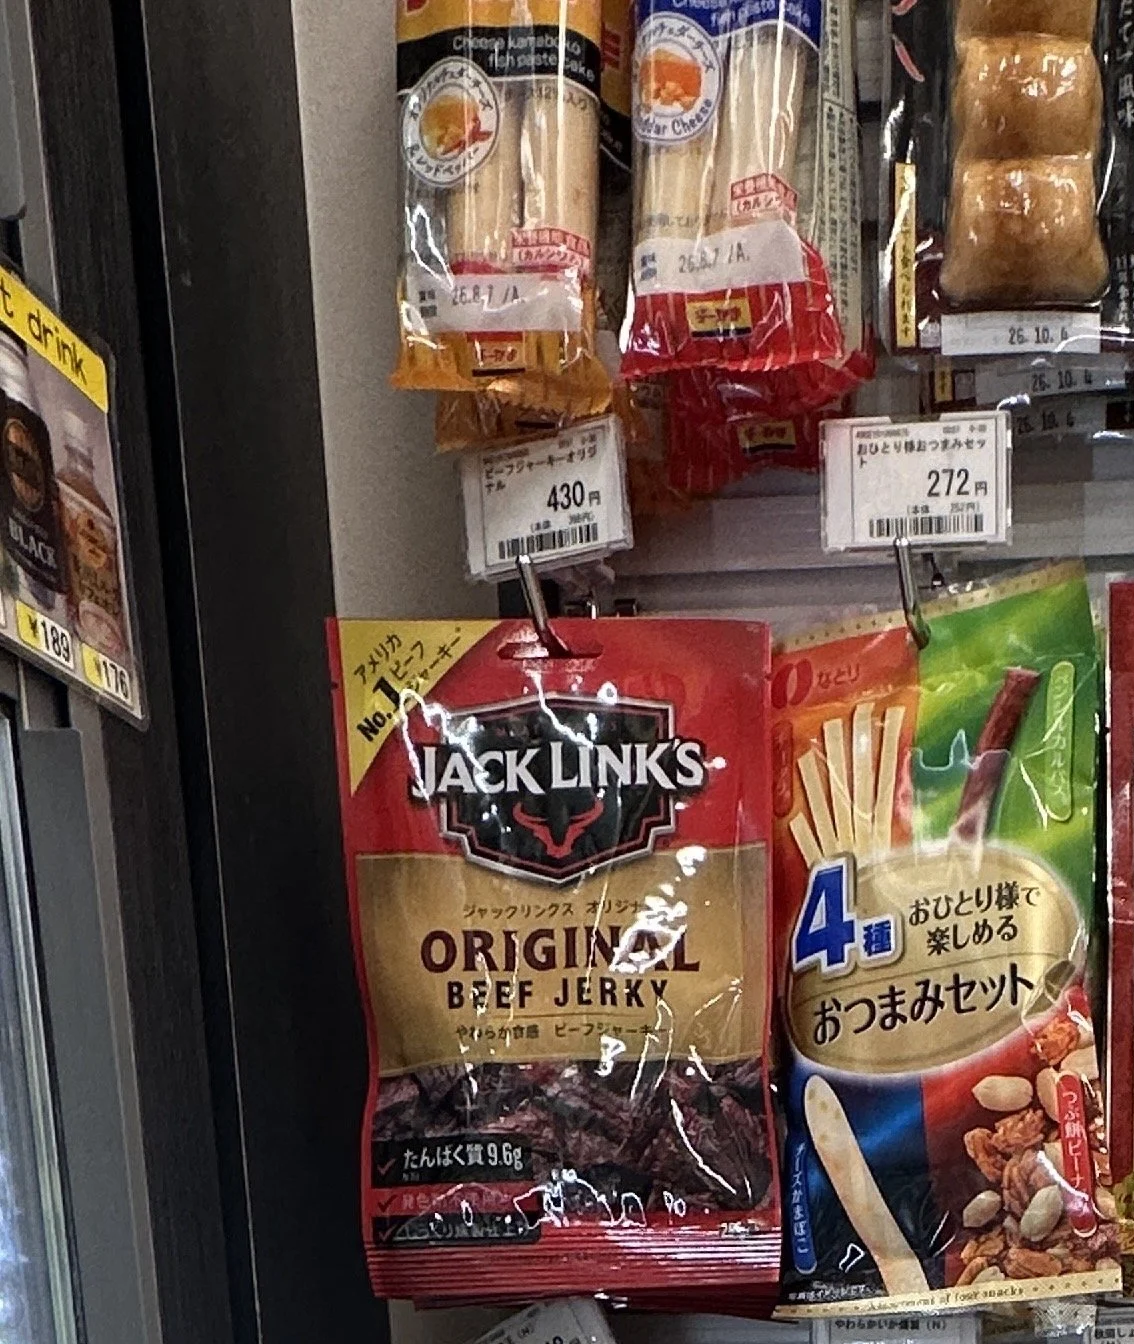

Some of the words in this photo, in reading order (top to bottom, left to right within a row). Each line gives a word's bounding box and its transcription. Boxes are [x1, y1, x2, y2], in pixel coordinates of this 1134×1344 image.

[27, 308, 88, 386] drink
[856, 437, 988, 456] おひとり様おつまみセッ
[858, 458, 868, 469] ト
[7, 506, 58, 570] BLACK
[28, 616, 72, 664] ¥189
[354, 633, 402, 685] アメリカ
[816, 663, 860, 690] なとり
[412, 745, 545, 799] JACK
[550, 738, 705, 791] LINK'S
[463, 901, 574, 920] ジャックリンクス
[909, 881, 1041, 926] おひとり様で
[421, 926, 701, 975] ORIGINAL
[926, 913, 1019, 957] 楽しめる
[448, 980, 534, 1010] BEEF
[553, 978, 669, 1009] JERKY
[812, 963, 1035, 1048] おつまみセット
[456, 1024, 540, 1041] やわらか食感
[553, 1023, 668, 1039] ビーフジャーキー
[487, 1141, 524, 1172] 9.6g
